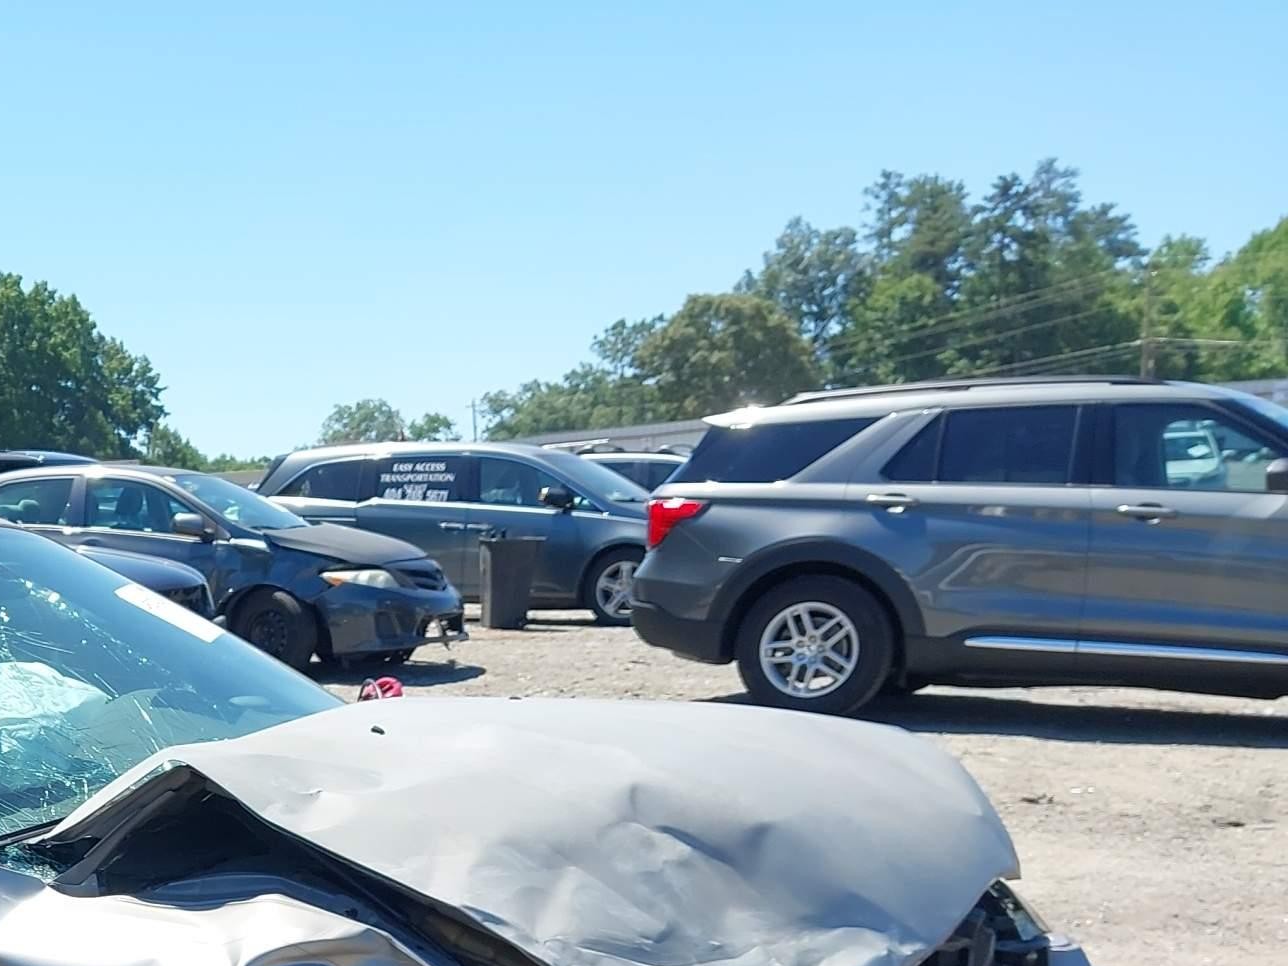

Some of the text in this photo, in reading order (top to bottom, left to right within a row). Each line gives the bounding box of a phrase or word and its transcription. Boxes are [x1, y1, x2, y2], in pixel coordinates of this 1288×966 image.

[393, 462, 446, 472] EASY ACCESS
[380, 473, 456, 482] TRANSPORTATION
